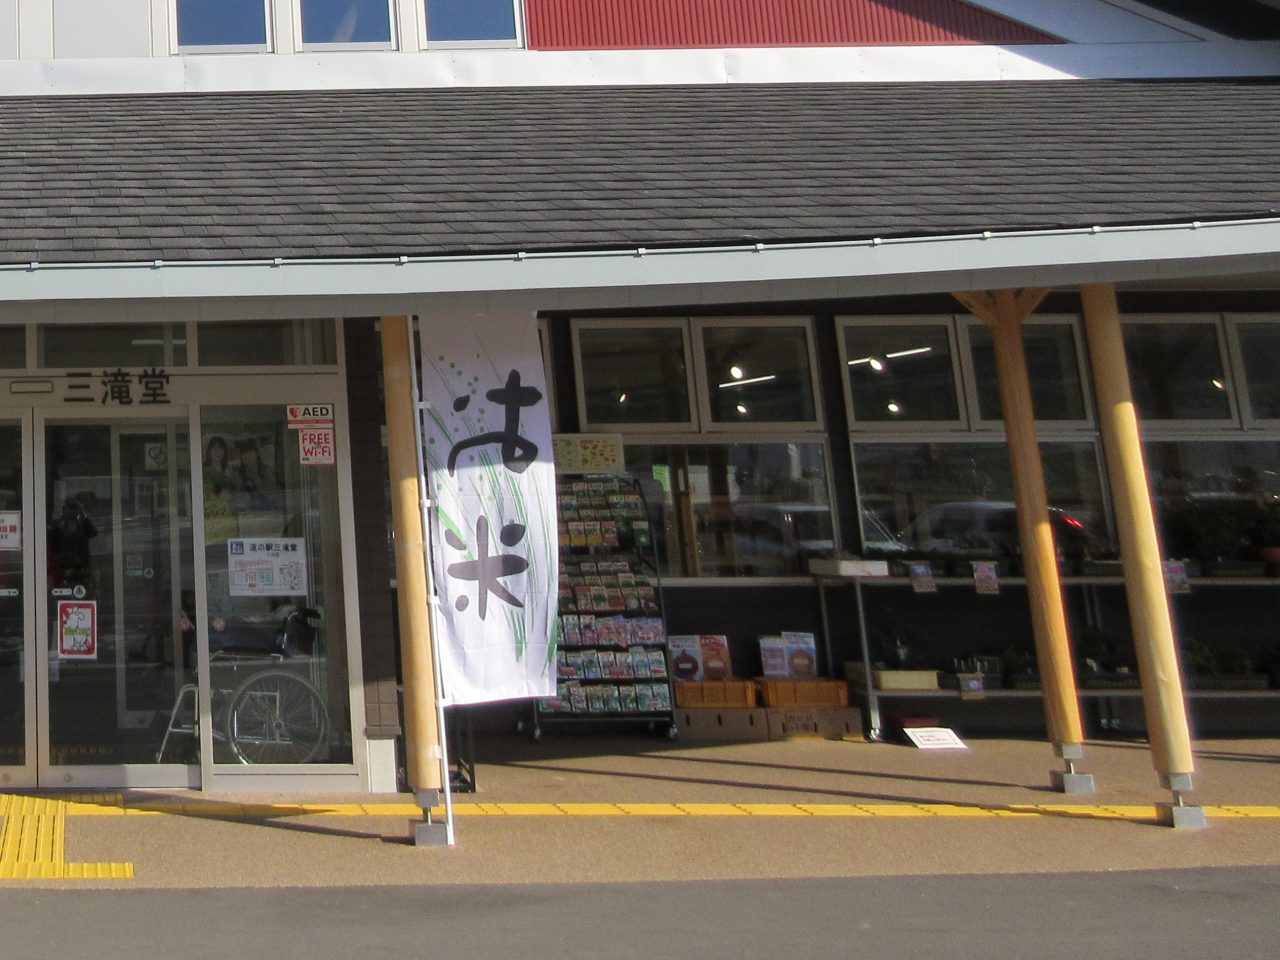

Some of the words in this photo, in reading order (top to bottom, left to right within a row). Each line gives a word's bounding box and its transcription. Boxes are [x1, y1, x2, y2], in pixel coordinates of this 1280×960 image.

[63, 367, 171, 405] 三滝堂
[302, 407, 329, 417] AED
[301, 433, 330, 445] FREE
[303, 446, 331, 457] Wi-Fi
